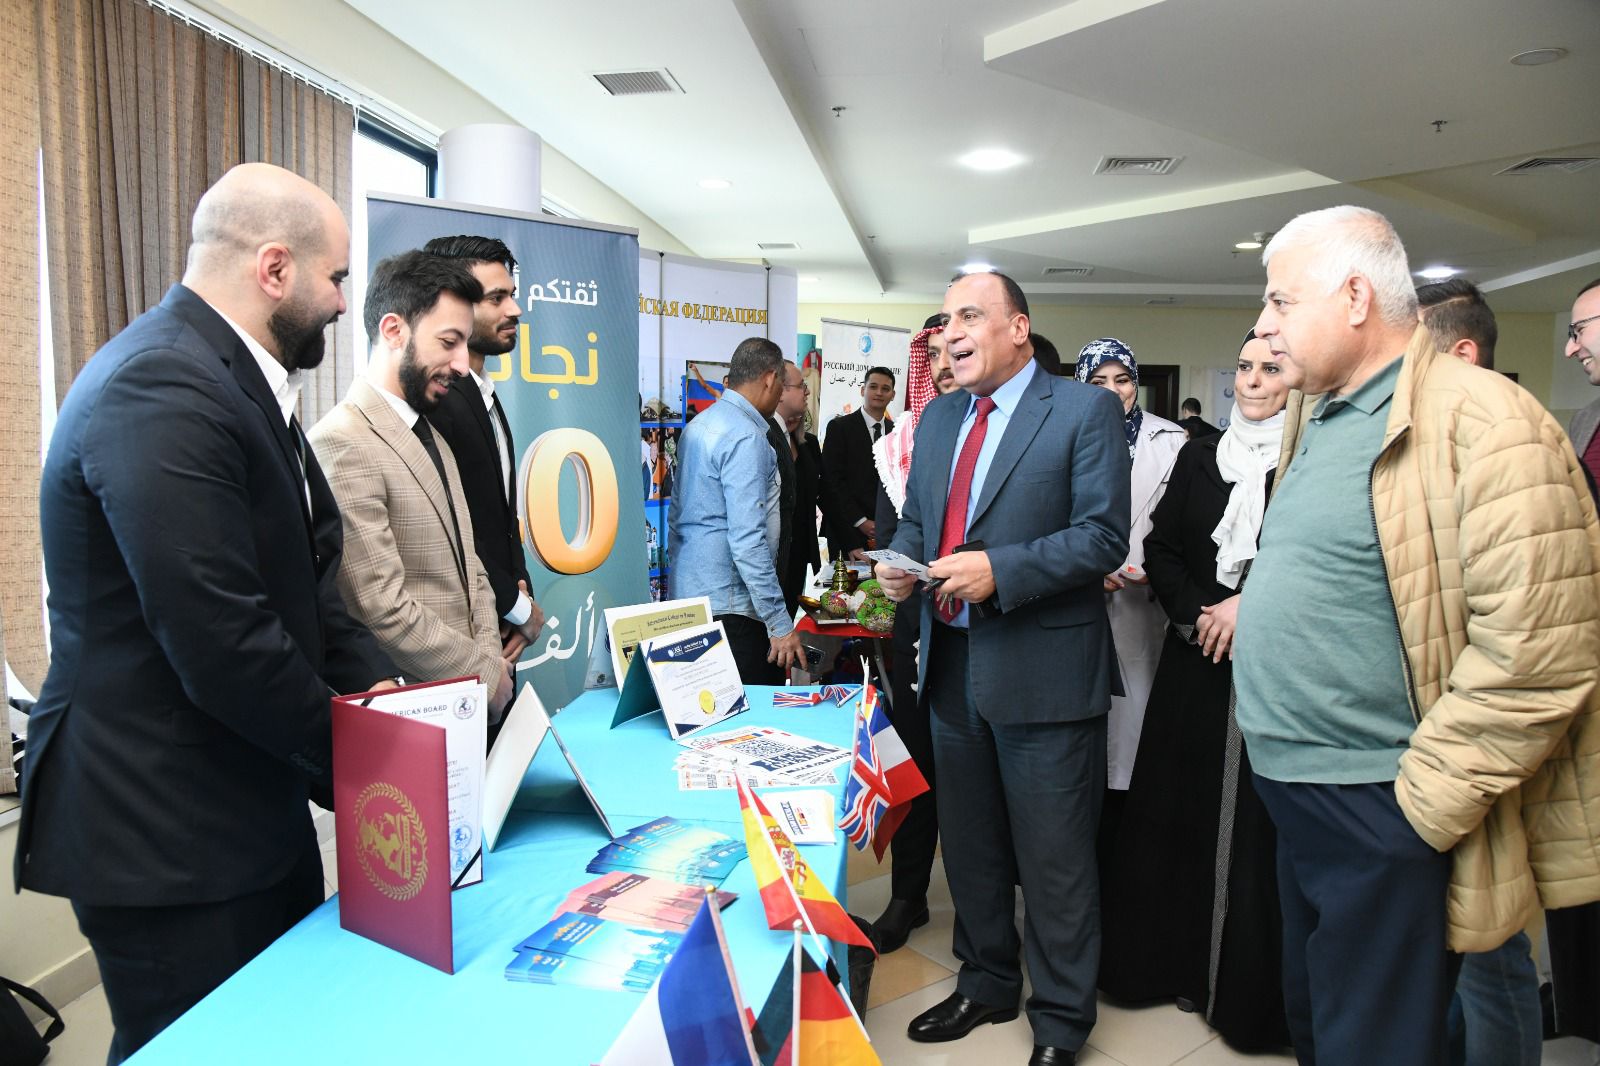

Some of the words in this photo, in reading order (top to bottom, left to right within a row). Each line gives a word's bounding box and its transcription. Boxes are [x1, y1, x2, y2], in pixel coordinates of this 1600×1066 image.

[528, 278, 598, 312] ثقتكم
[682, 302, 767, 326] ФЕДЕРАЦИЯ
[824, 361, 855, 371] РУССКИЙ
[516, 591, 595, 672] ألف
[423, 704, 448, 714] BOARD
